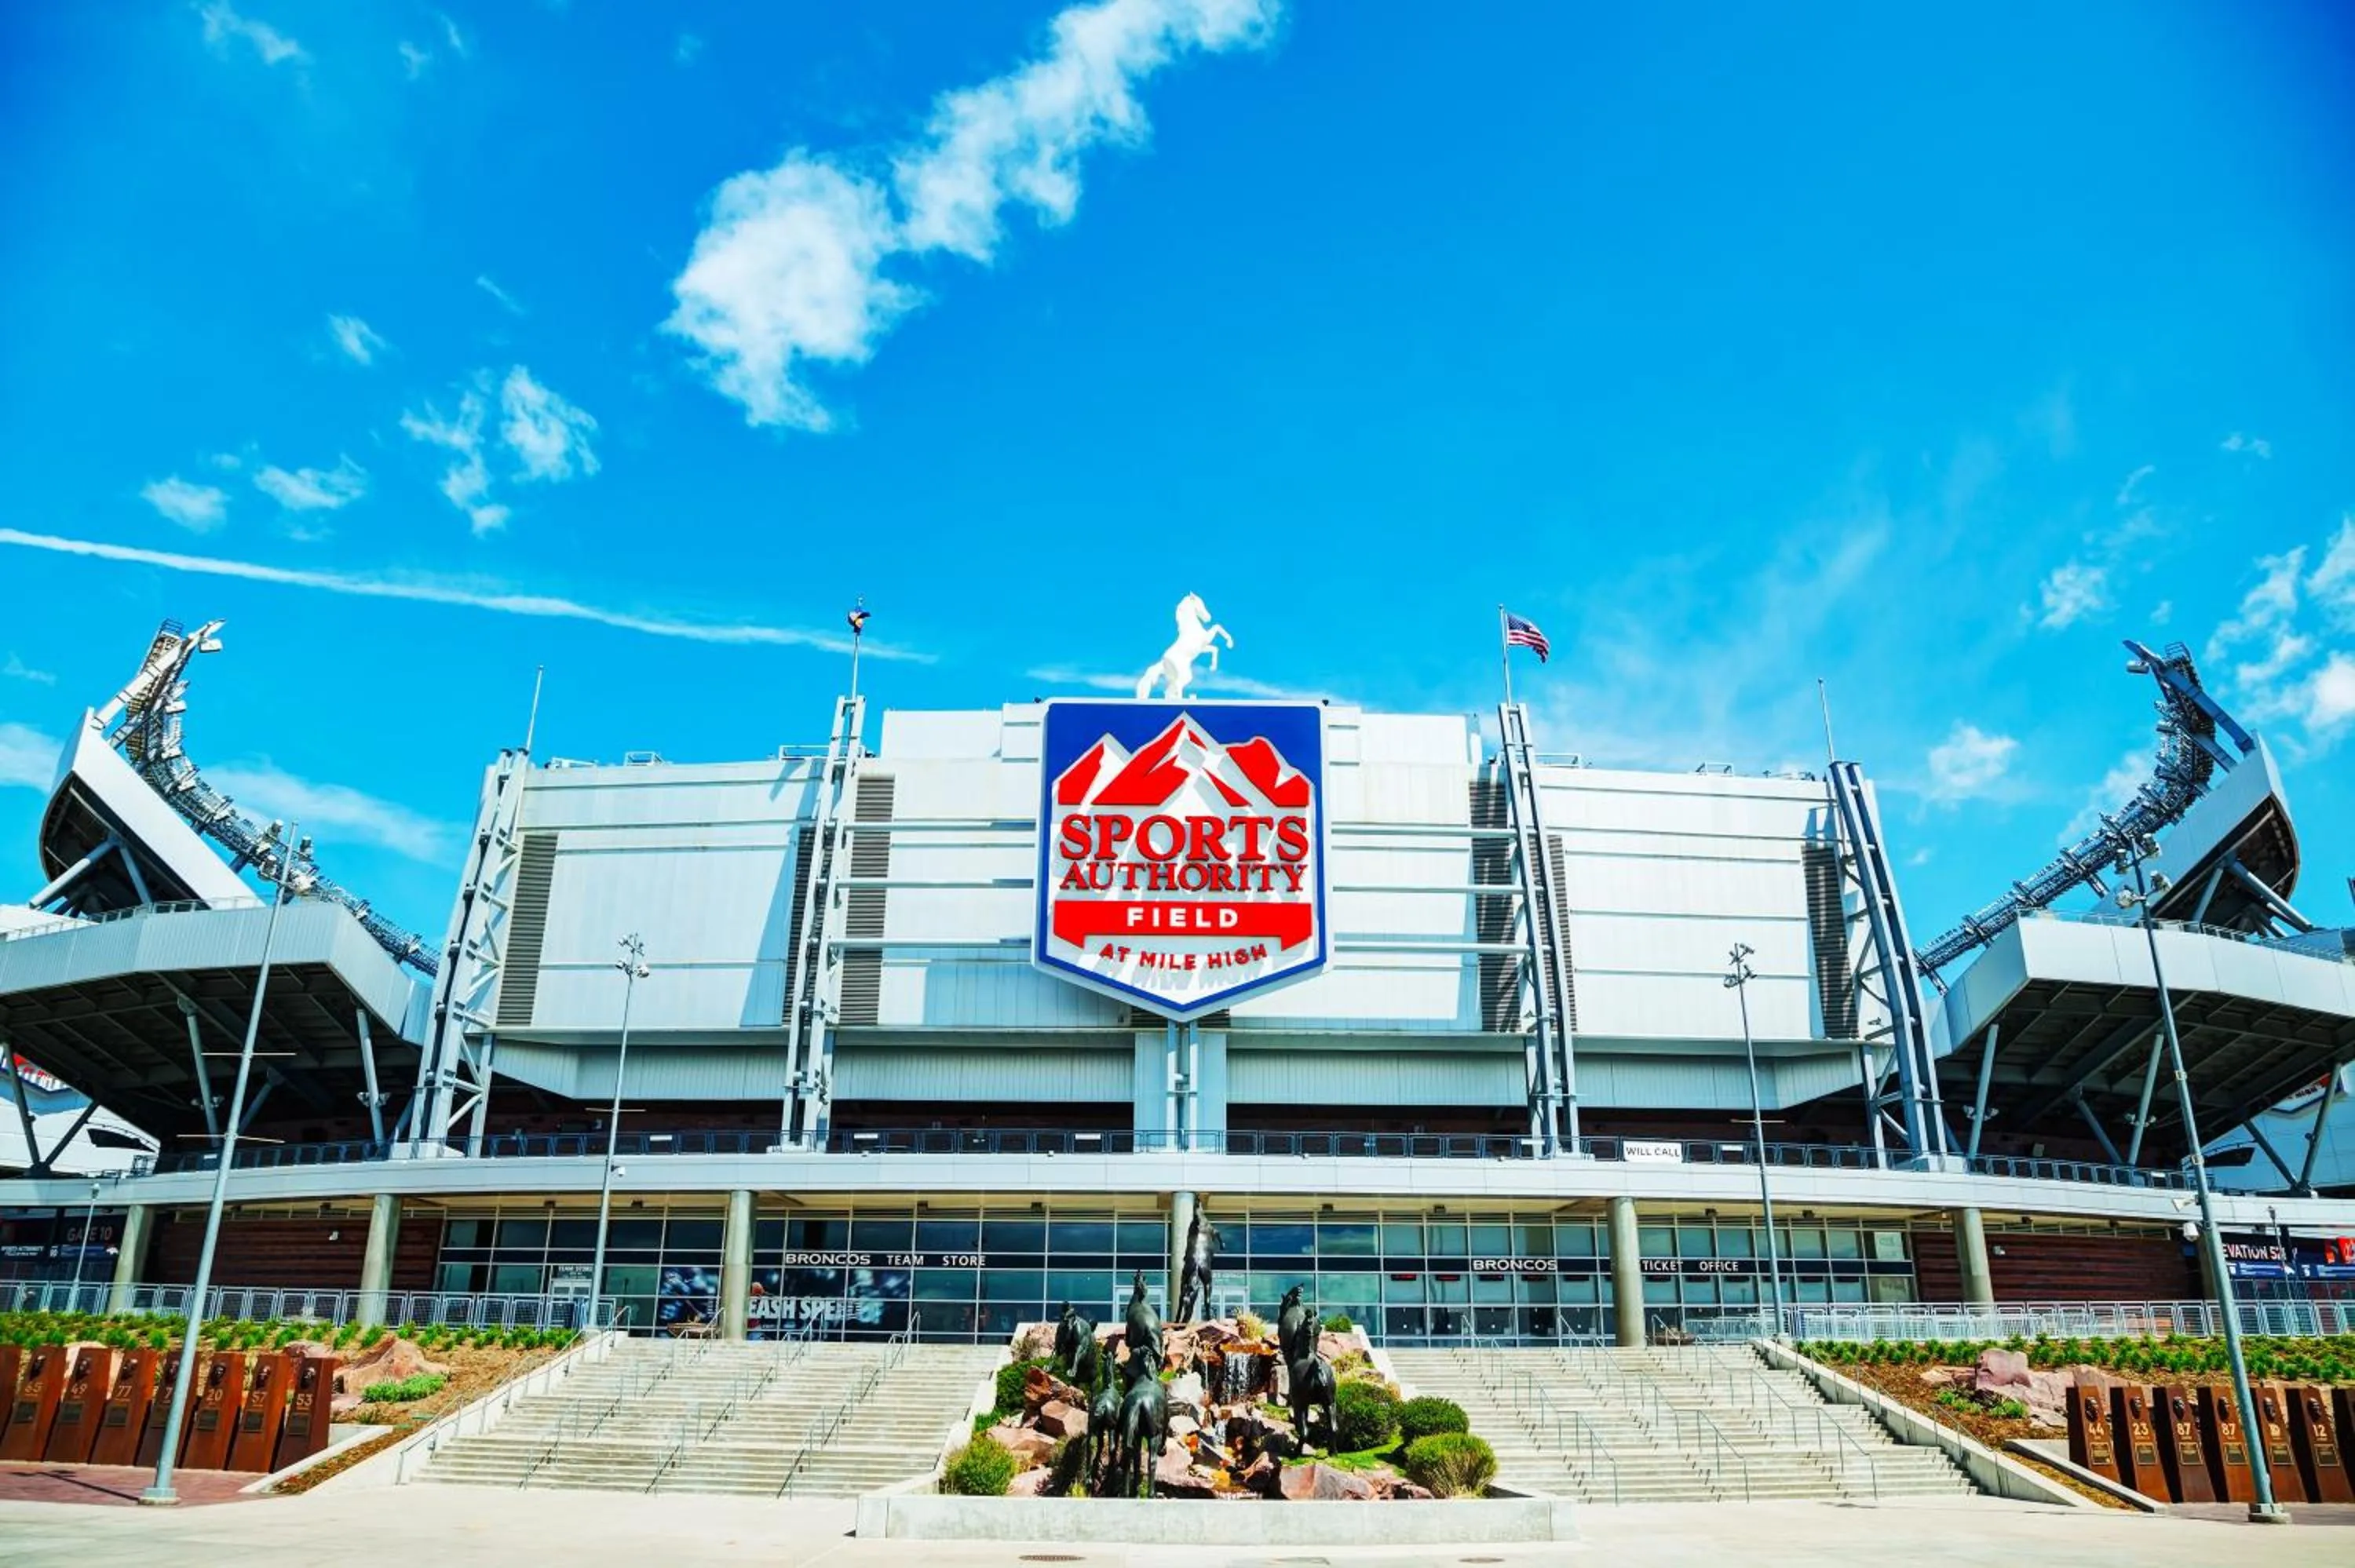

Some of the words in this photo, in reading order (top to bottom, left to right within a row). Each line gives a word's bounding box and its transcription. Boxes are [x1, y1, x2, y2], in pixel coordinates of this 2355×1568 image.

[1059, 814, 1309, 862] SPORTS
[1060, 862, 1308, 892] AUTHORITY
[1126, 907, 1239, 928] FIELD
[1099, 943, 1130, 963] AT
[1139, 951, 1197, 971] MILE
[1207, 943, 1269, 969] HIGH
[1626, 1146, 1652, 1157] WILL
[1654, 1147, 1681, 1158] CALL
[67, 1226, 99, 1242] GAE
[2222, 1242, 2269, 1260] EVATION
[786, 1253, 871, 1266] BRONCOS
[886, 1255, 925, 1266] TEAM
[941, 1255, 986, 1267] STORE
[1473, 1259, 1558, 1271] BRONCOS
[1641, 1260, 1684, 1271] TICKET
[1699, 1260, 1740, 1272] OFFICE
[748, 1297, 795, 1318] EASH
[118, 1385, 133, 1397] 77
[206, 1389, 223, 1401] 20
[251, 1391, 268, 1403] 57
[296, 1393, 313, 1406] 53
[2088, 1422, 2105, 1435] 44
[2132, 1422, 2149, 1435] 23
[2177, 1422, 2191, 1435] 87
[2221, 1423, 2236, 1435] 87
[2312, 1424, 2328, 1437] 12
